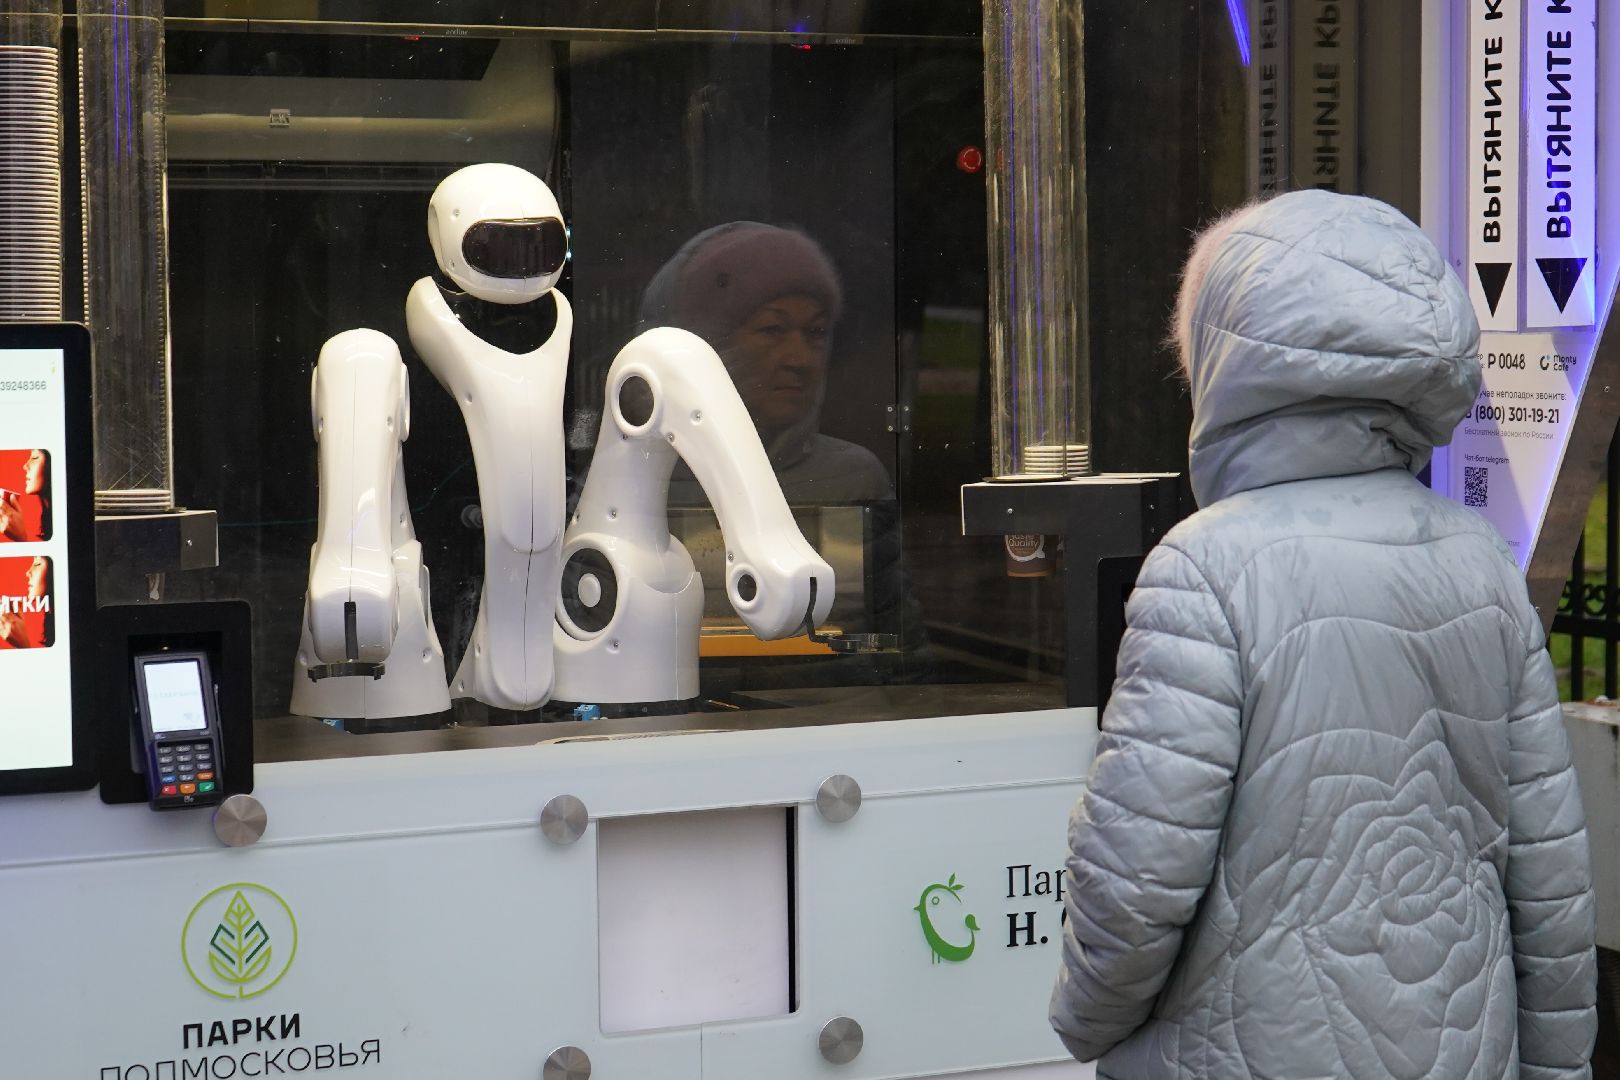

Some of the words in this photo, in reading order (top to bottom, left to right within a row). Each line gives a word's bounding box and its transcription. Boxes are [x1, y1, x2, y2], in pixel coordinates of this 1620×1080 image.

[1483, 36, 1503, 243] ВЫТЯНИТЕ
[1546, 30, 1572, 239] ВЫТЯНИТЕ
[1498, 353, 1526, 370] 0048
[1553, 354, 1577, 365] Monty
[1553, 363, 1569, 372] Cafe
[1475, 404, 1505, 425] (800)
[1508, 406, 1560, 424] 301-19-21
[1006, 864, 1067, 902] Пар
[182, 1013, 301, 1049] ПАРКИ
